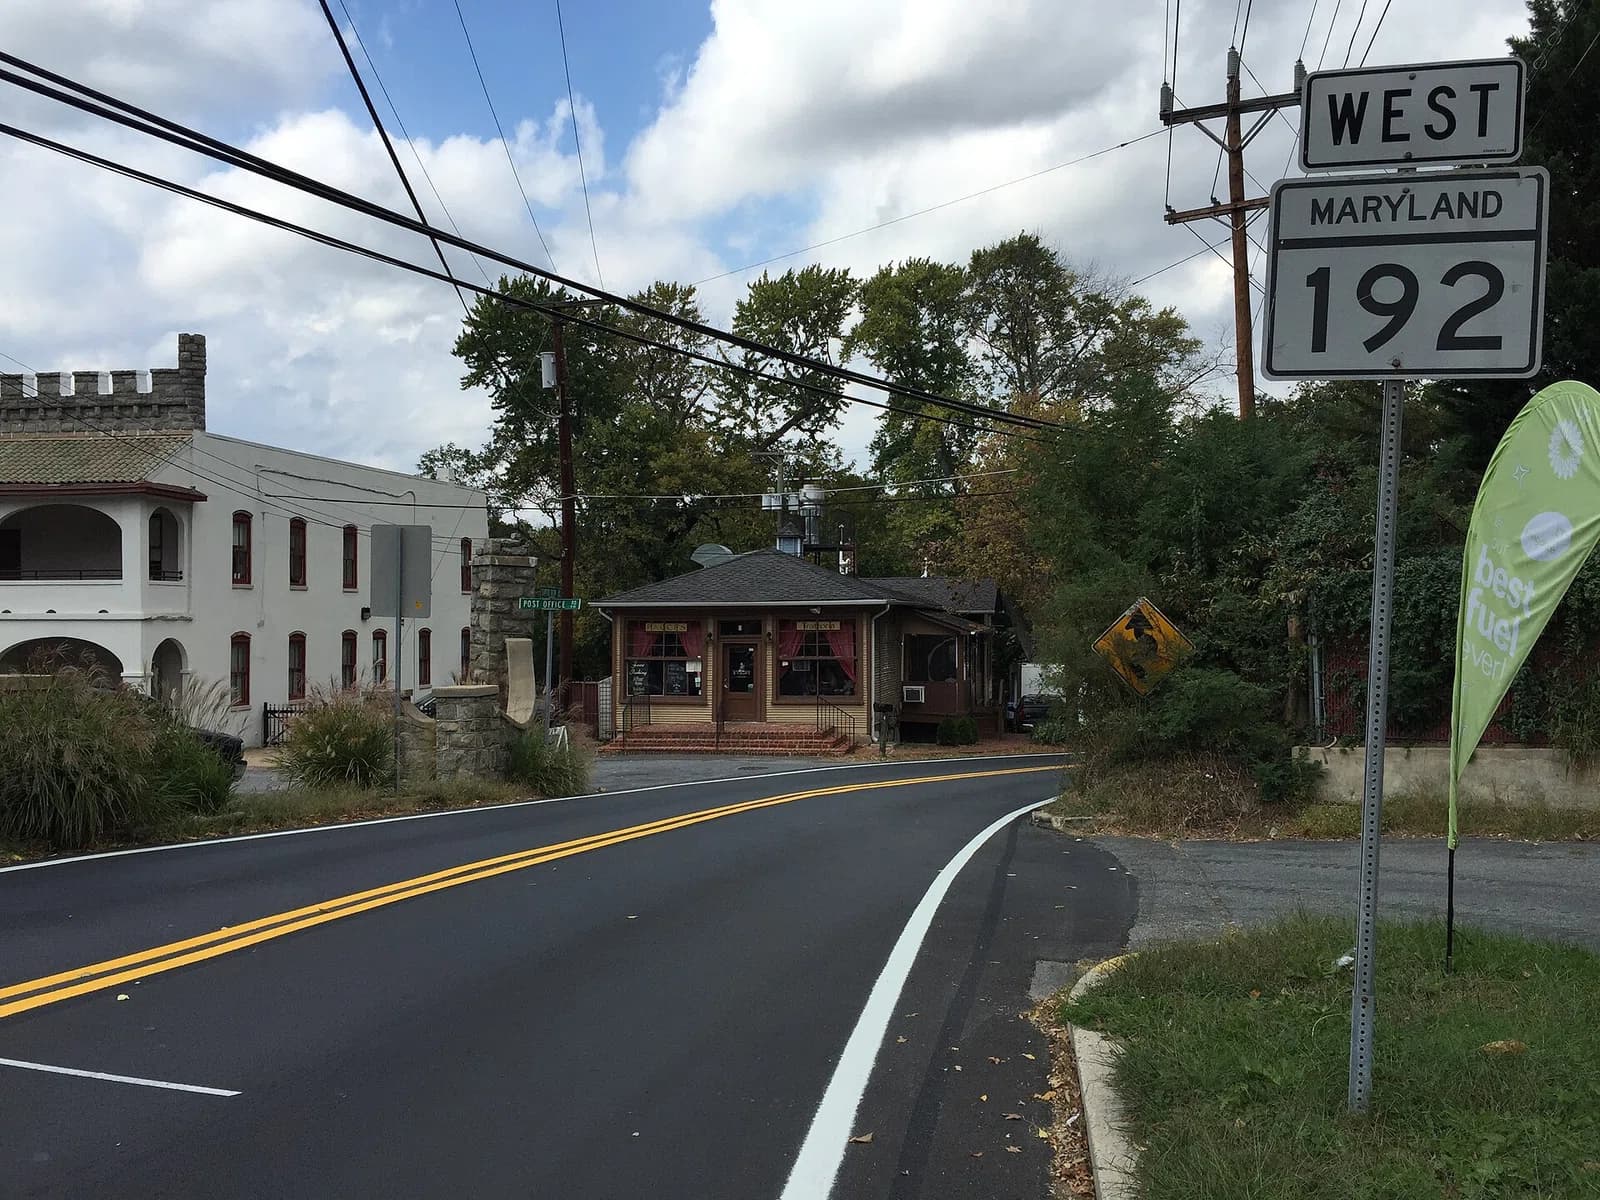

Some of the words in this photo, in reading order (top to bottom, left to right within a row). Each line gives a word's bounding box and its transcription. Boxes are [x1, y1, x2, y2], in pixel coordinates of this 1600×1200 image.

[1327, 82, 1500, 146] WEST
[1310, 190, 1503, 226] MARYLAND
[1305, 260, 1505, 354] 192
[523, 600, 540, 608] POST
[542, 600, 566, 609] OFFICE
[1475, 543, 1536, 619] best
[1465, 587, 1521, 658] fuel
